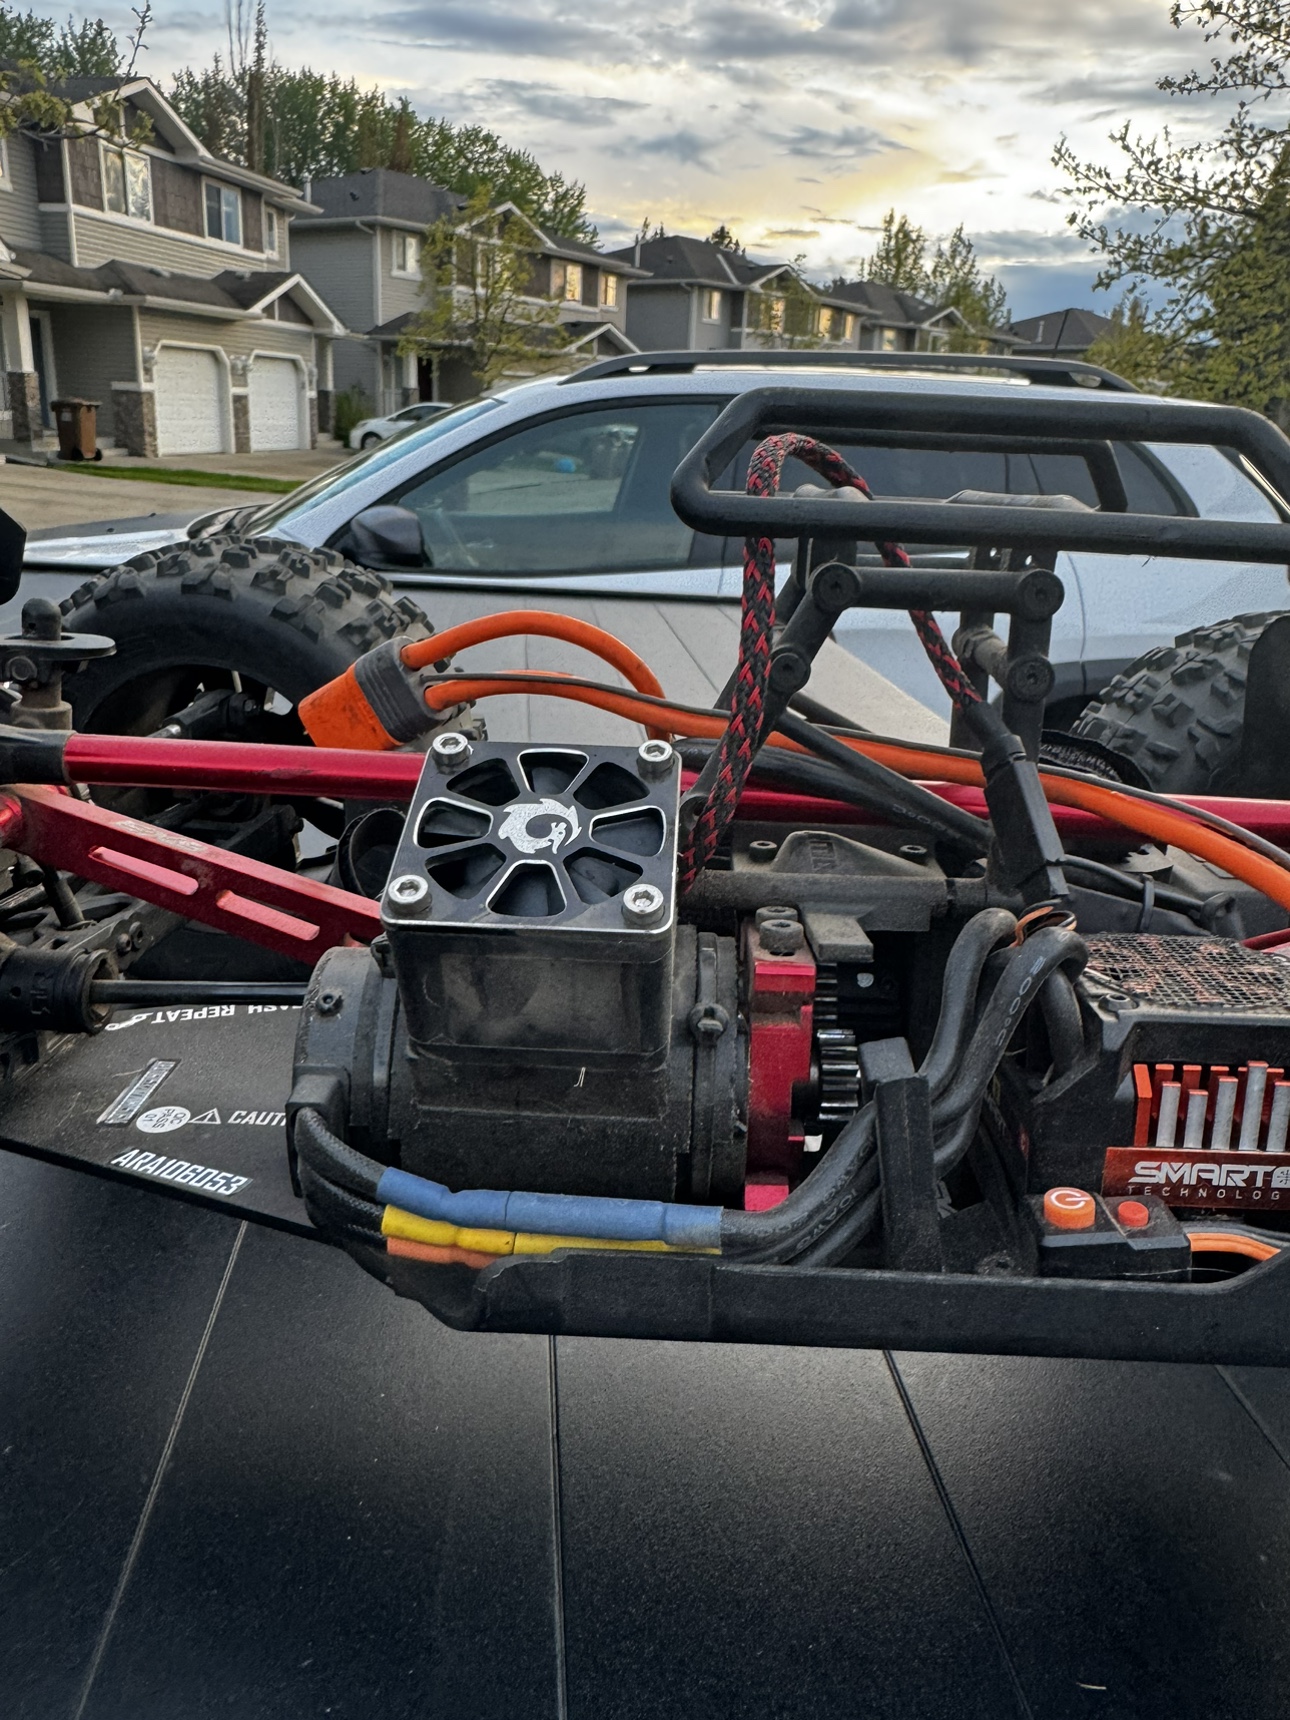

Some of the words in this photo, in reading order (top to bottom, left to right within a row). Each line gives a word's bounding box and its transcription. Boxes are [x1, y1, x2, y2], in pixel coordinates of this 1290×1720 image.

[151, 1005, 235, 1023] REPEAT
[110, 1149, 248, 1196] ARA106053
[1128, 1161, 1277, 1187] SMART
